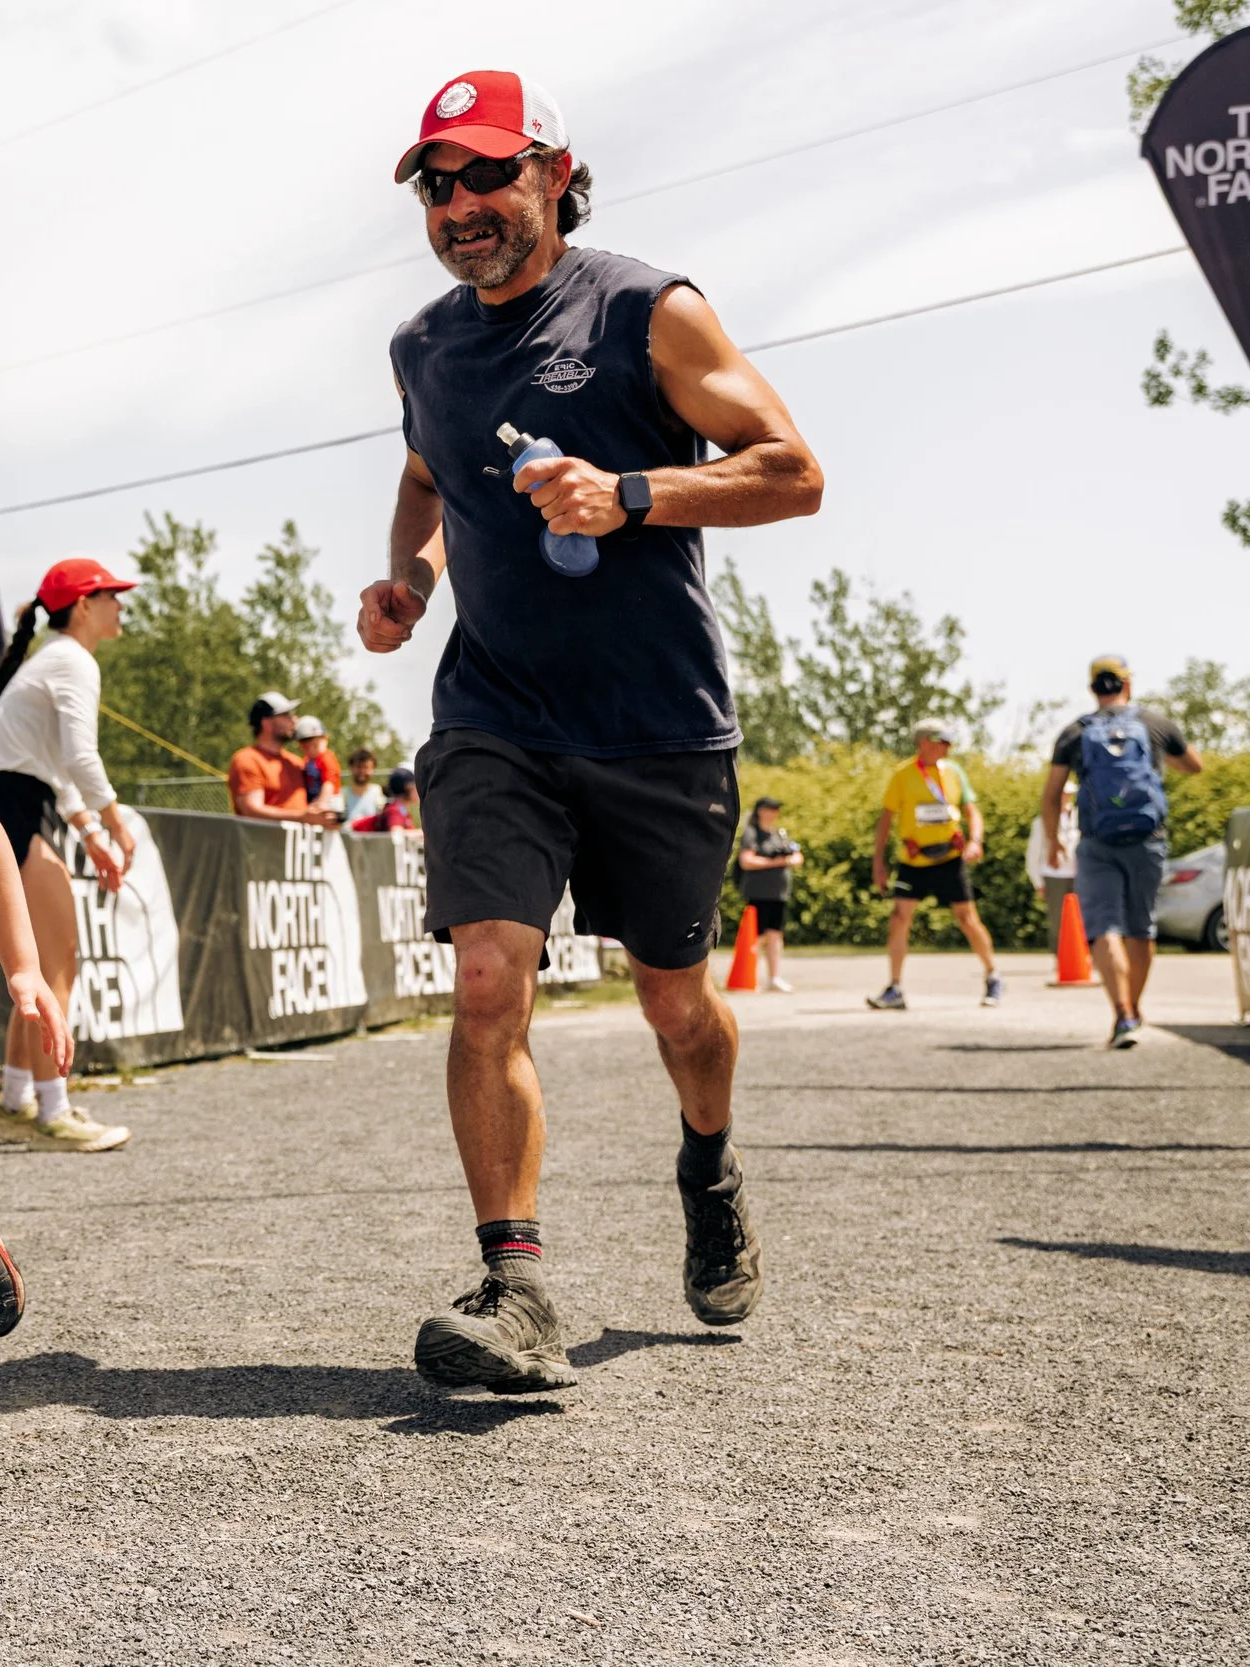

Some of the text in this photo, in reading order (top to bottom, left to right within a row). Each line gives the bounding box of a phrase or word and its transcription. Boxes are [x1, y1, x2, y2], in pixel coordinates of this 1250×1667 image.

[1165, 138, 1250, 180] NOR
[1207, 170, 1250, 207] FA
[534, 368, 596, 385] TREMBLAY
[281, 821, 324, 881] THE
[247, 879, 327, 950] NORTH
[67, 959, 125, 1043] ACE
[271, 946, 330, 1017] FACE
